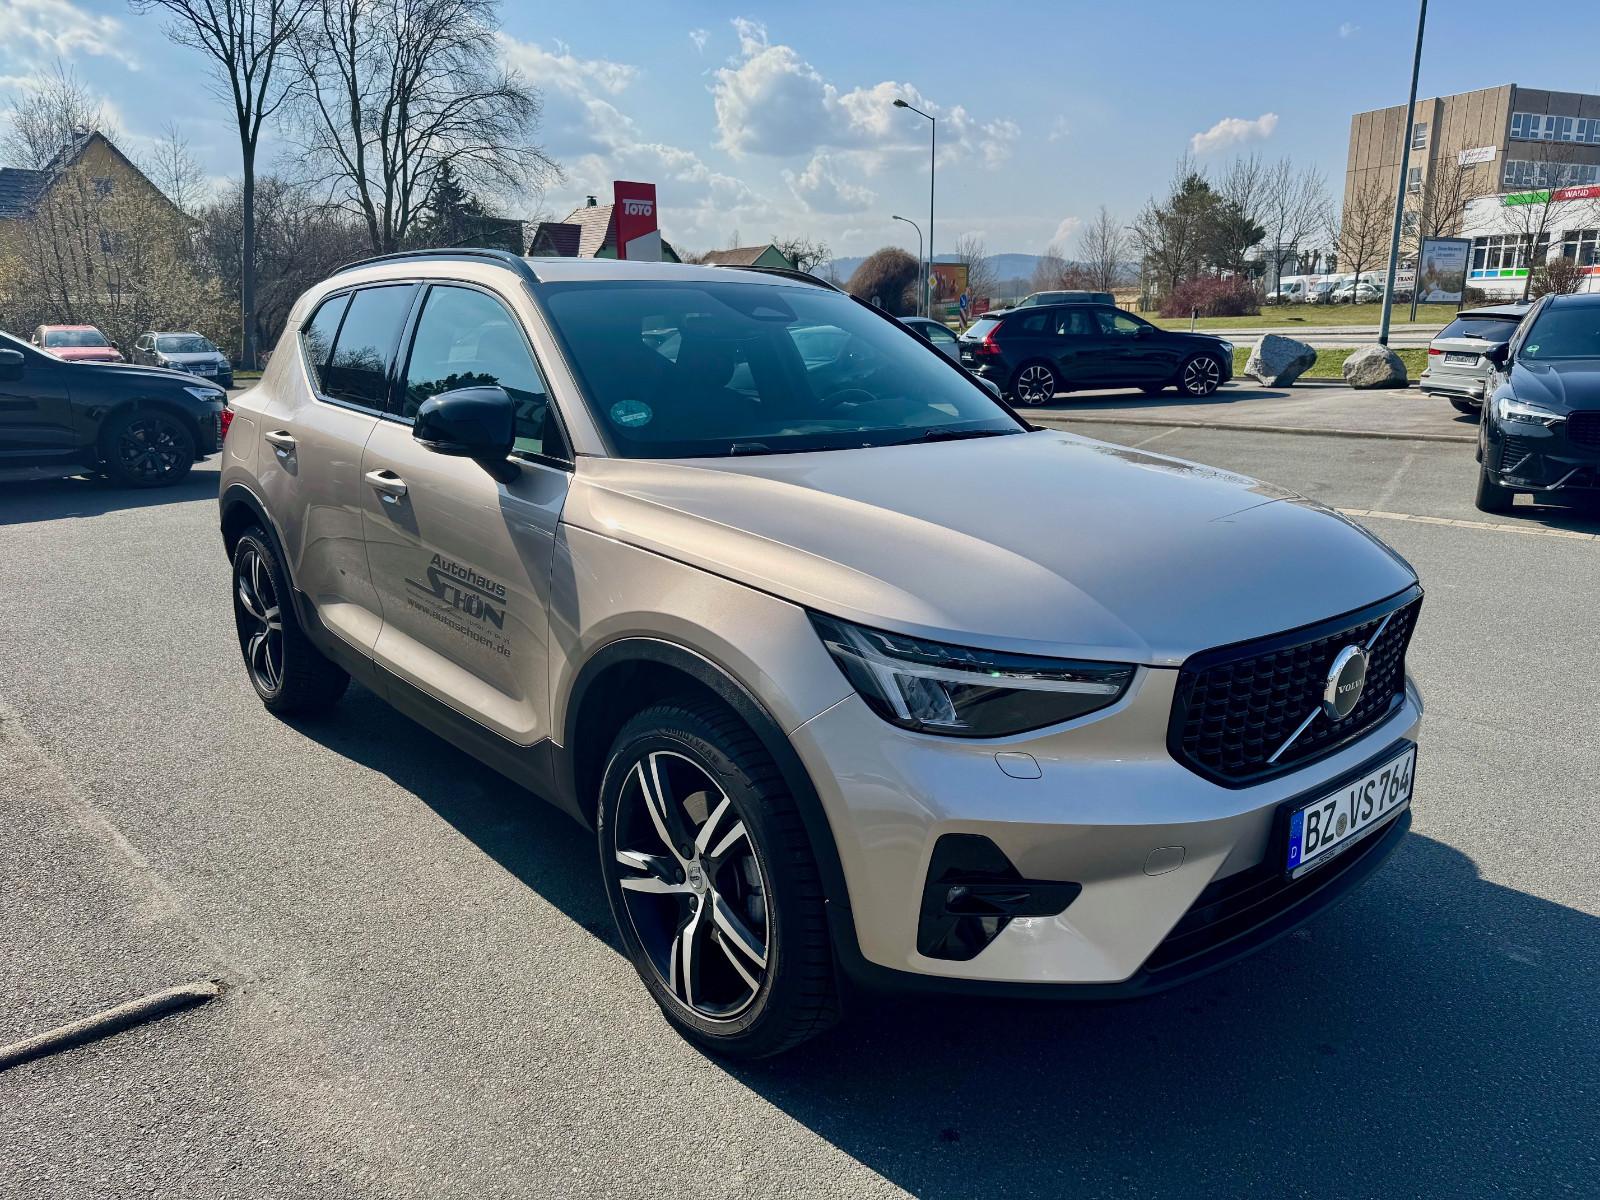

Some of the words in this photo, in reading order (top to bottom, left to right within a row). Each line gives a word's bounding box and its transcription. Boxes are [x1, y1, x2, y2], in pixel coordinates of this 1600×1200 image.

[1565, 190, 1588, 198] WAND
[430, 553, 506, 597] Autohaus
[407, 597, 511, 658] www.autoschoen.de
[1304, 800, 1337, 855] BZ
[1291, 846, 1298, 859] D
